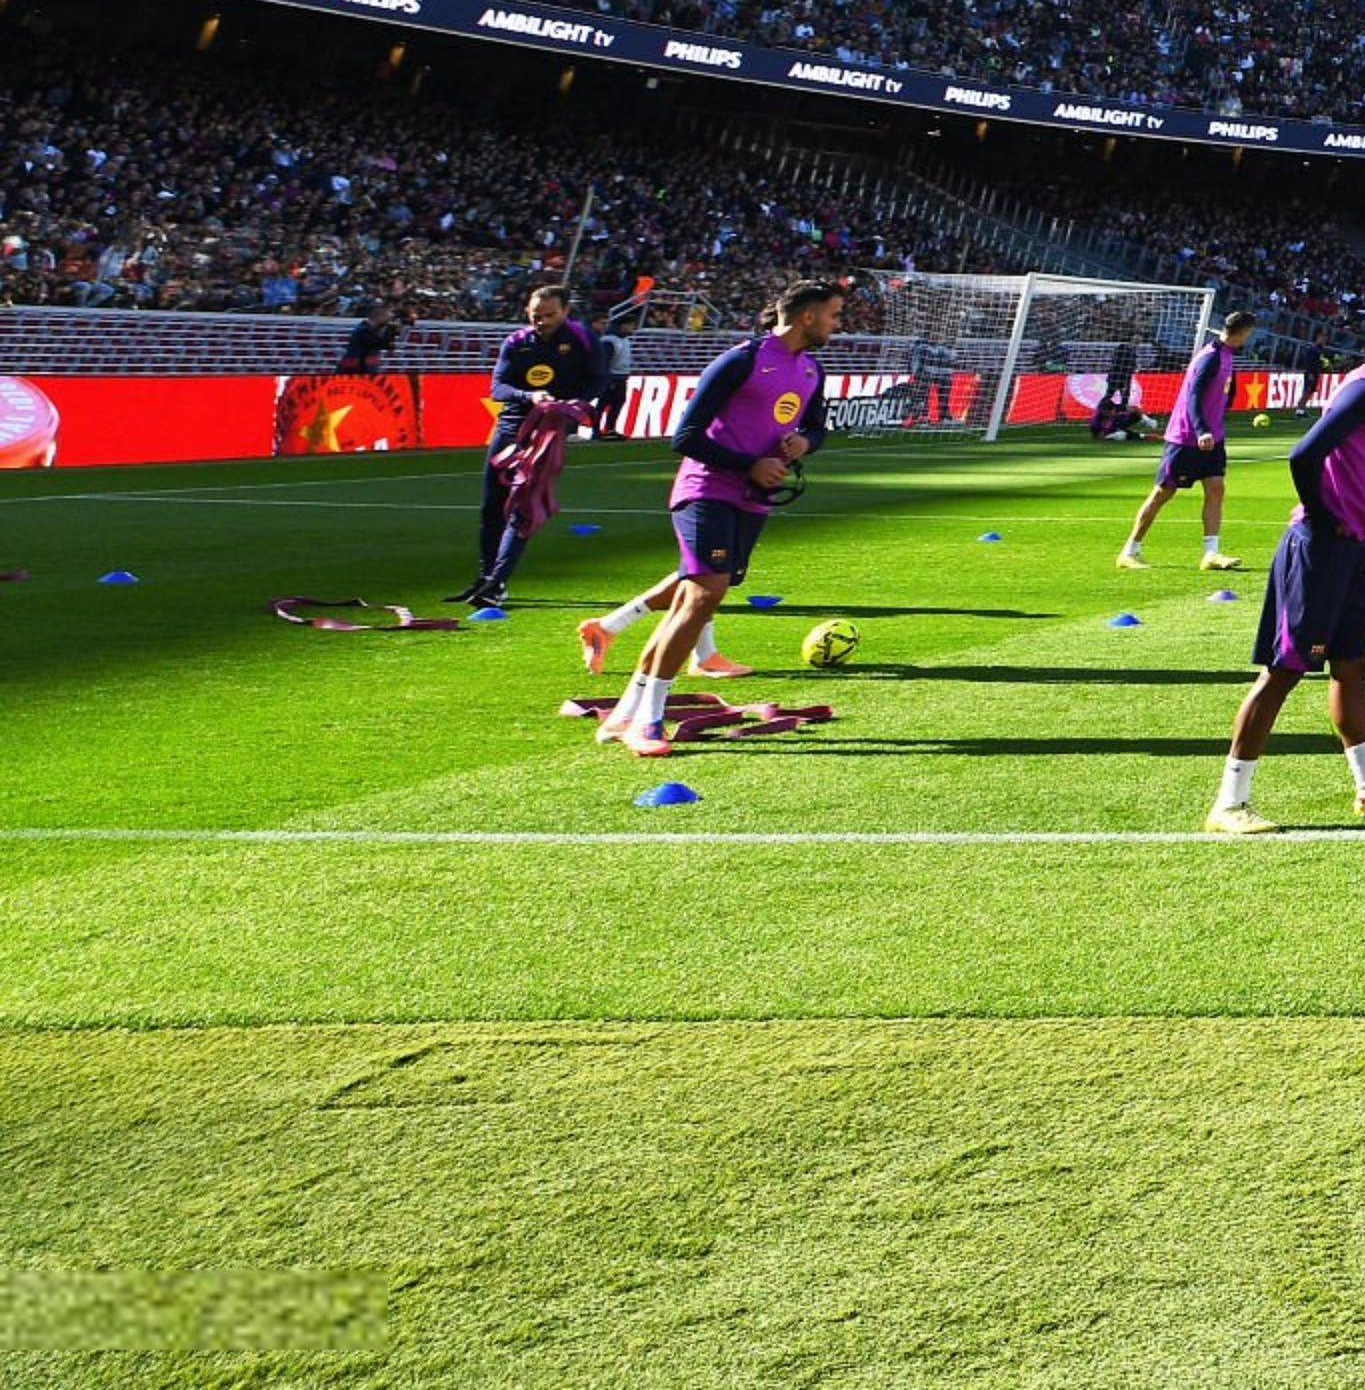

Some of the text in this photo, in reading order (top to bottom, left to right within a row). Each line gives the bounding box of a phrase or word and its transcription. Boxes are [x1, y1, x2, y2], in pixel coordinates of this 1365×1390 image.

[478, 9, 615, 49] AMBILIGHT tv
[663, 40, 743, 70] PHILIPS
[788, 61, 903, 95] AMBILIGHT tv
[944, 86, 1011, 111] PHILIPS
[1053, 103, 1164, 130] AMBILIGHT tv
[1208, 121, 1279, 142] PHILIPS
[826, 397, 905, 431] FOOTBALL
